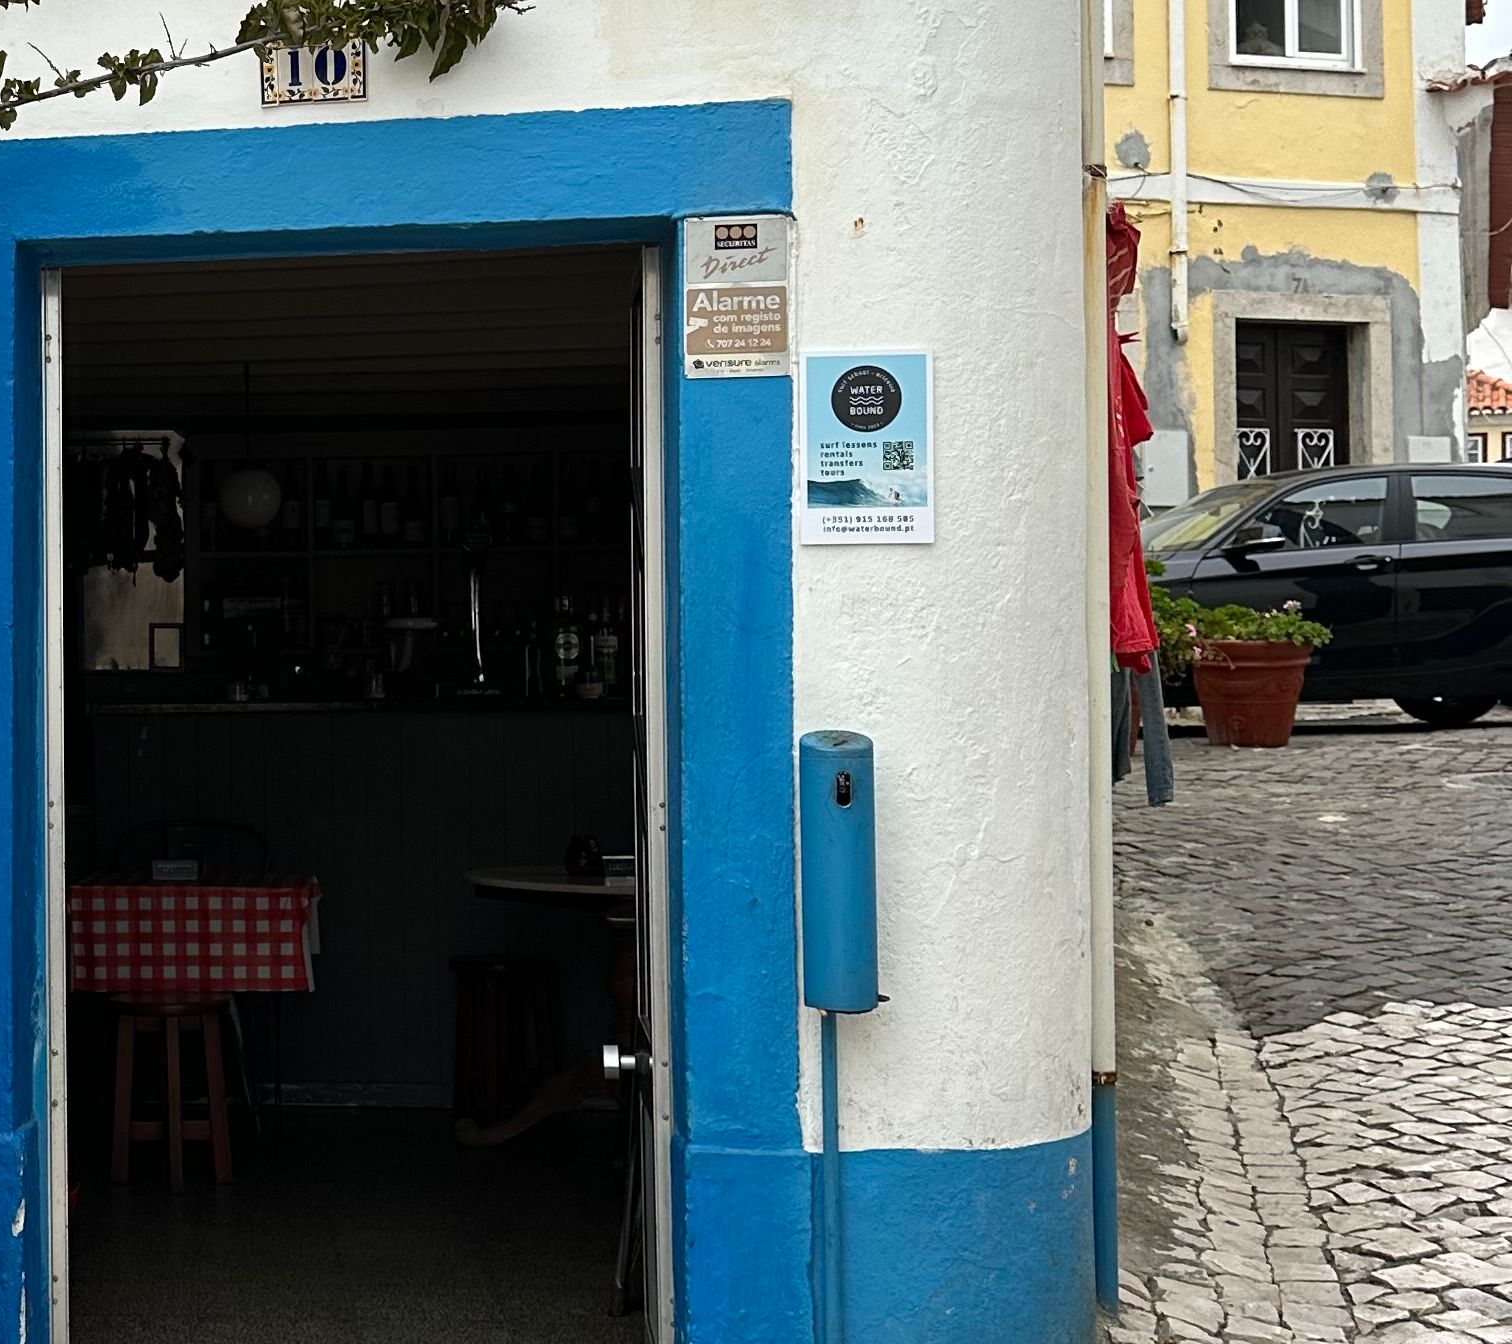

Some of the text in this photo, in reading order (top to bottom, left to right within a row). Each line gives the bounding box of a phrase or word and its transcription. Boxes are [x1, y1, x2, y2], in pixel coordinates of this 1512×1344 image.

[288, 45, 347, 86] 10
[700, 247, 778, 279] Direct
[693, 290, 781, 312] Alarme
[713, 311, 782, 324] com registo
[713, 322, 782, 335] de imagens
[716, 338, 772, 348] 707 24 12 24
[850, 385, 883, 395] WATER
[849, 406, 884, 415] BOUND
[820, 441, 878, 449] surf lessons
[820, 450, 853, 458] rentals
